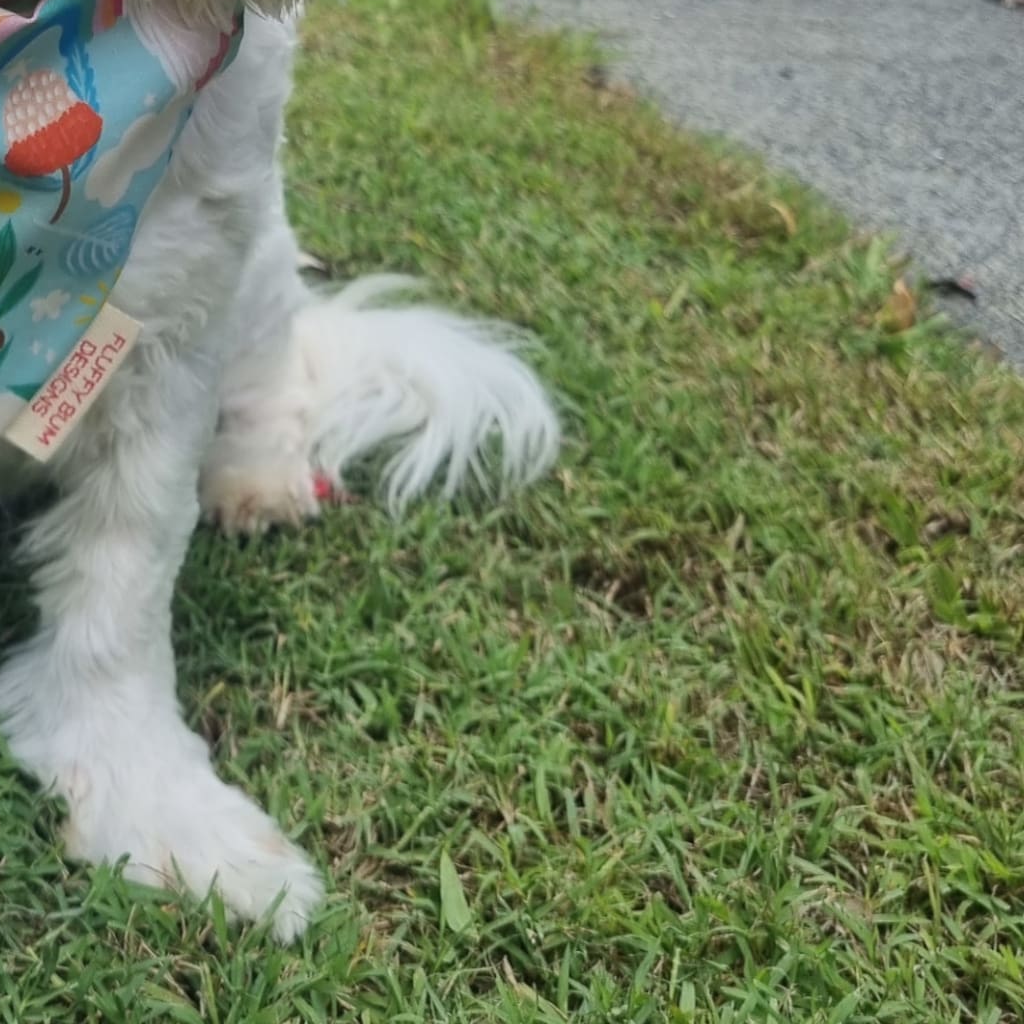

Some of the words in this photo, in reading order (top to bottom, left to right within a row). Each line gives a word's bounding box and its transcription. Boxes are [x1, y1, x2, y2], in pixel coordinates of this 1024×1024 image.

[32, 340, 97, 418] DESIGNS
[72, 333, 126, 404] FLUFFY
[38, 401, 76, 446] BUM
